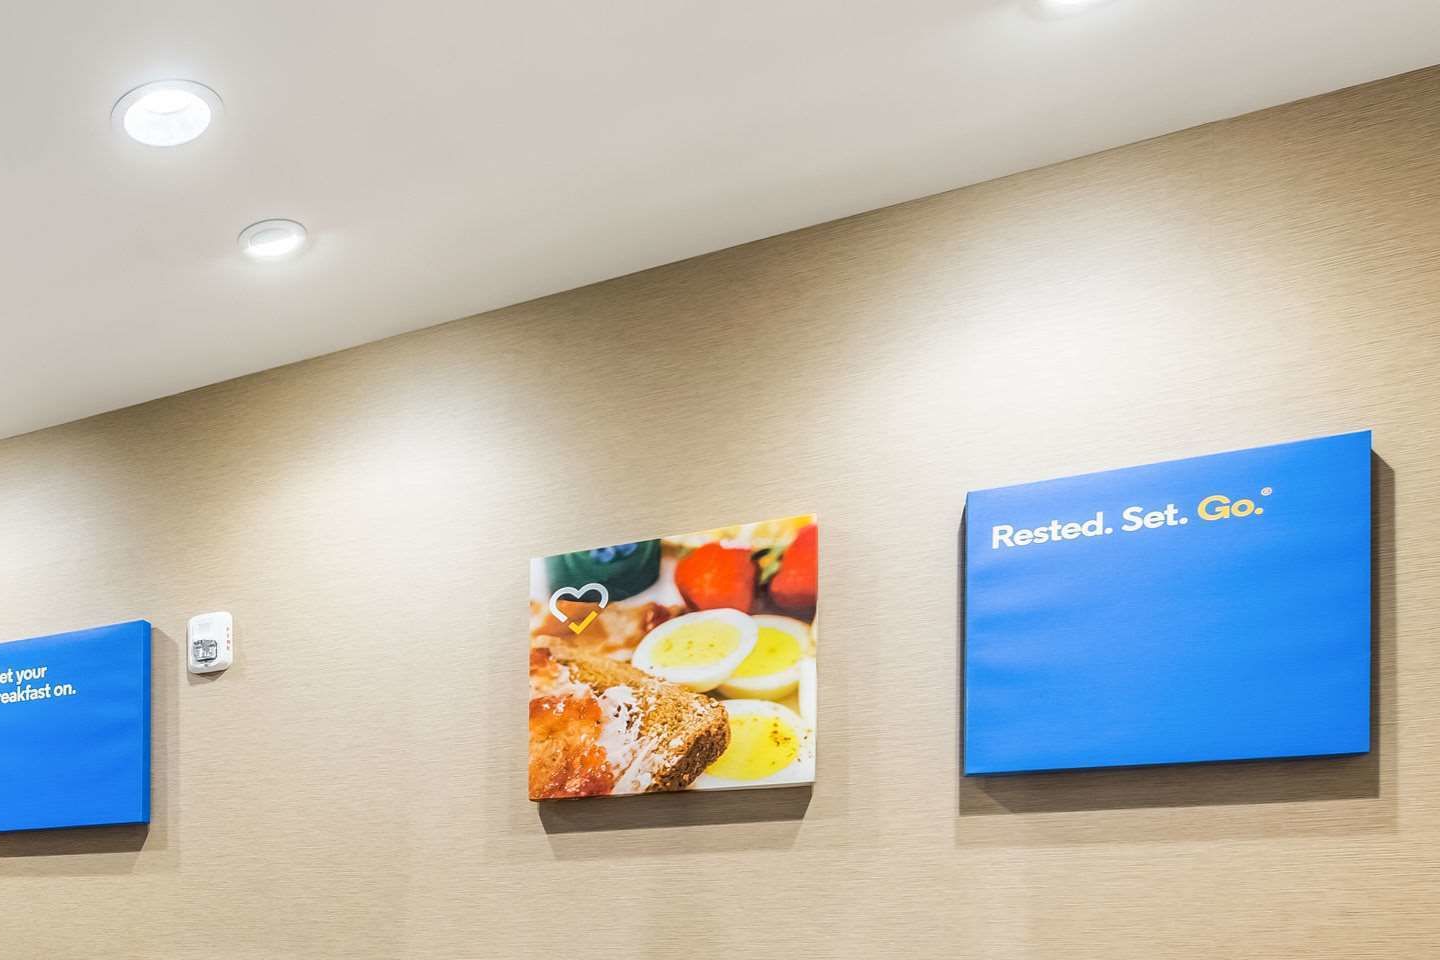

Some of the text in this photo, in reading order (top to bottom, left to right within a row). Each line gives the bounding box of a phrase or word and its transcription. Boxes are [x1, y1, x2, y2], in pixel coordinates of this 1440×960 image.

[991, 511, 1114, 550] Rested.
[1120, 503, 1190, 533] Set.
[16, 666, 48, 686] your
[54, 683, 77, 697] on.
